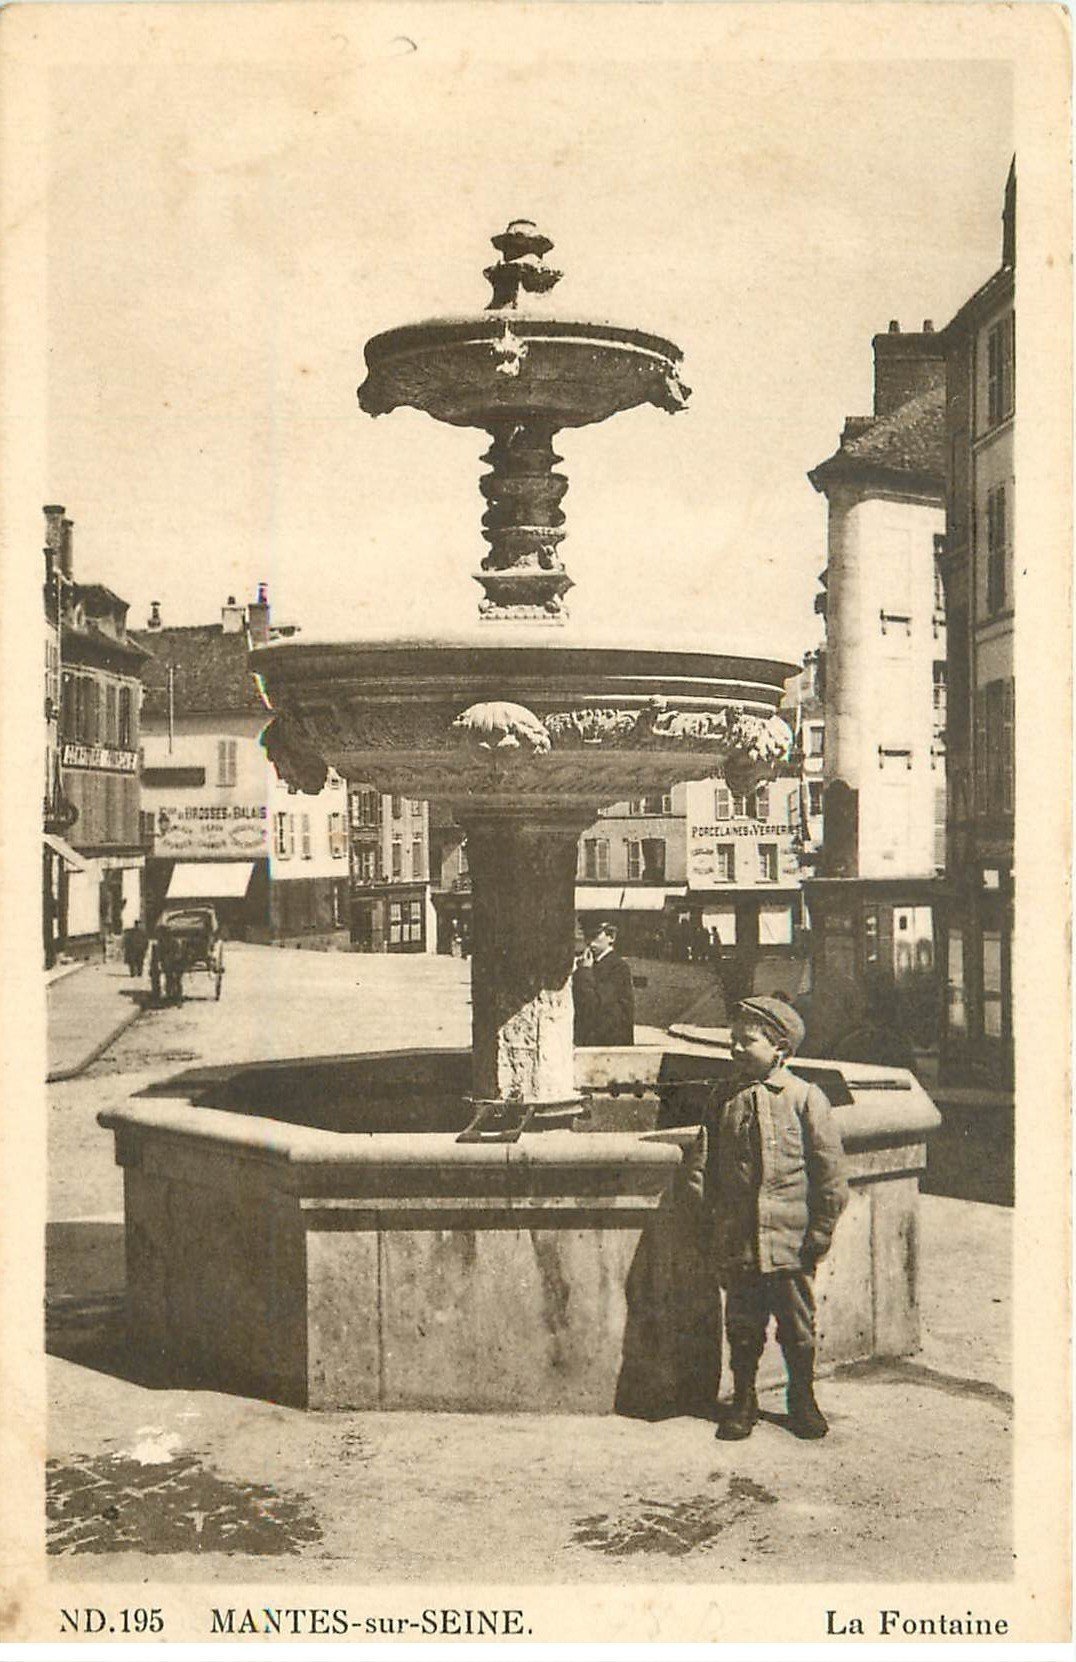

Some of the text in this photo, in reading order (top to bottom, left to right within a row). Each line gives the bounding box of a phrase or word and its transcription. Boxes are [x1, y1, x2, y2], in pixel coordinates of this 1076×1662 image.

[185, 806, 228, 820] BROSSES
[233, 806, 267, 820] BALAIS
[692, 826, 748, 838] PORCELAINES
